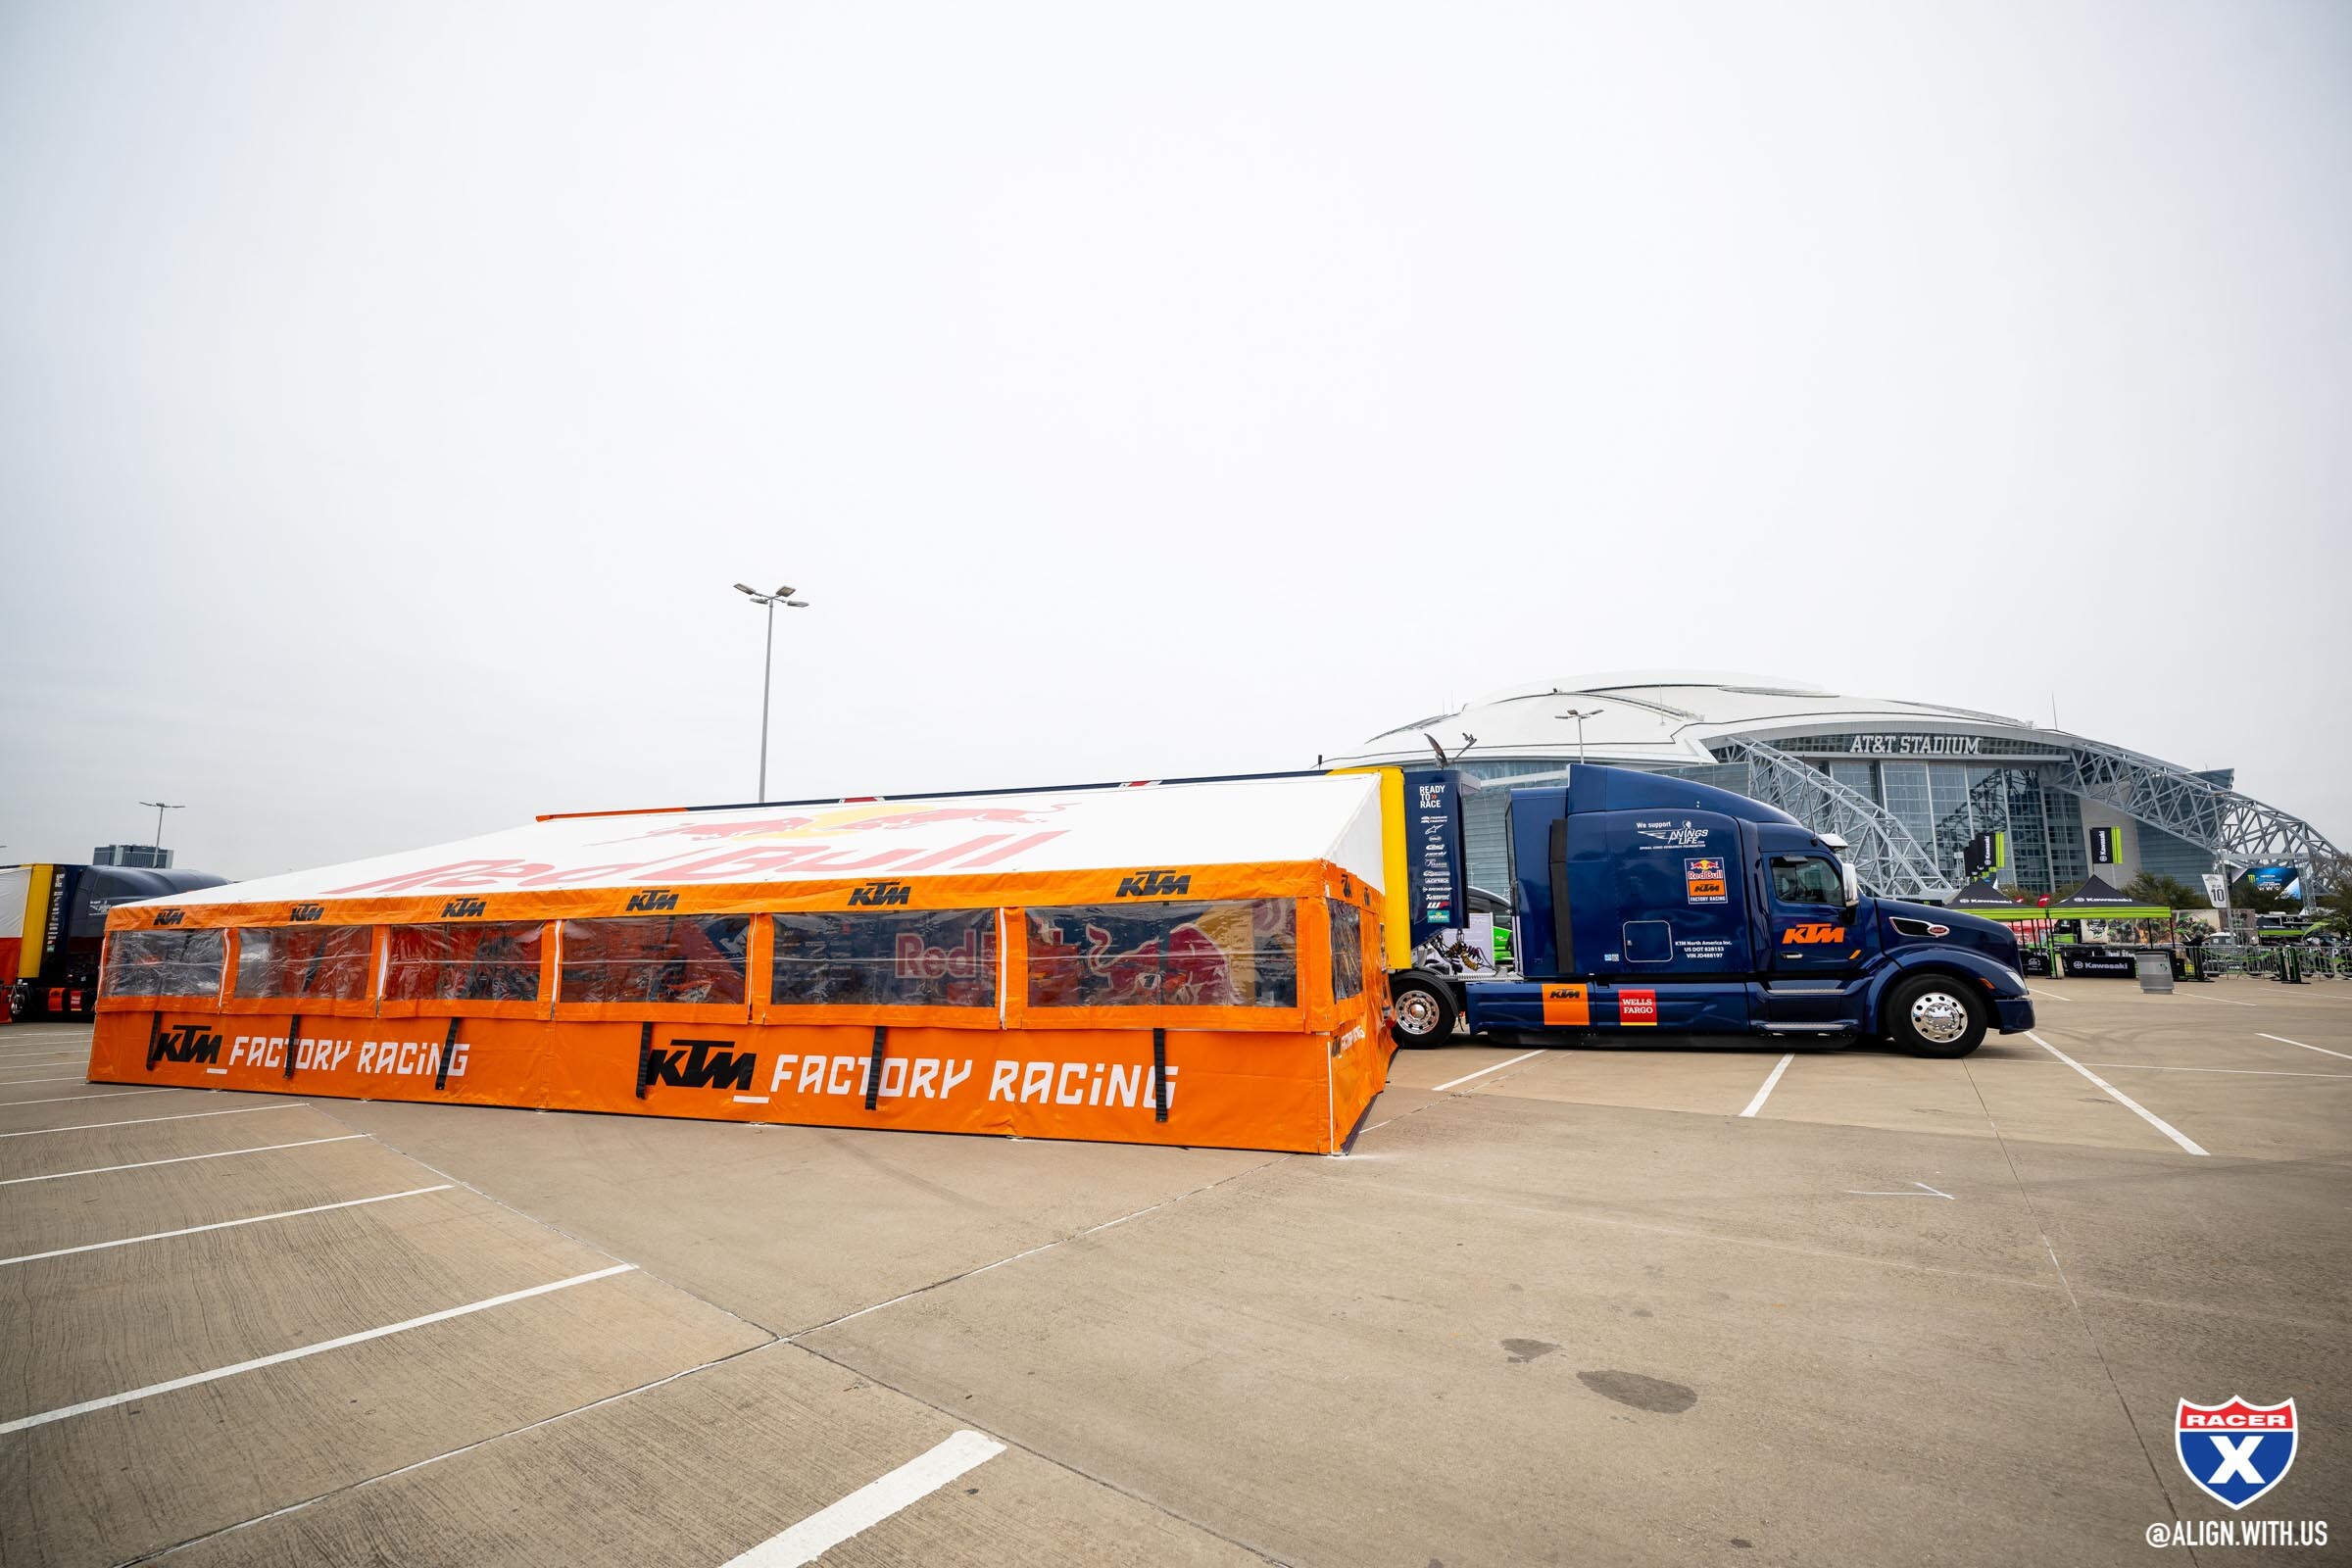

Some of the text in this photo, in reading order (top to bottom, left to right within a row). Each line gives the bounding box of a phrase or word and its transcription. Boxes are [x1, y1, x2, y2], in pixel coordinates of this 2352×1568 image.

[1850, 735, 1982, 755] AT&T STADIUM
[1419, 785, 1446, 794] READY
[1420, 800, 1442, 808] RACE
[627, 829, 1072, 881] Bull
[1115, 870, 1192, 897] KTM
[1688, 870, 1724, 880] Red Bull
[847, 882, 911, 906] KTM
[1694, 884, 1720, 893] KTM
[2212, 889, 2225, 902] 10
[441, 898, 487, 917] KTM
[625, 890, 679, 911] KTM
[153, 908, 186, 925] KTM
[290, 904, 324, 921] KTM
[1782, 923, 1845, 944] KTM
[895, 929, 977, 979] Red
[1550, 989, 1580, 999] KTM
[152, 1025, 223, 1064] KTM
[647, 1039, 757, 1091] KTM
